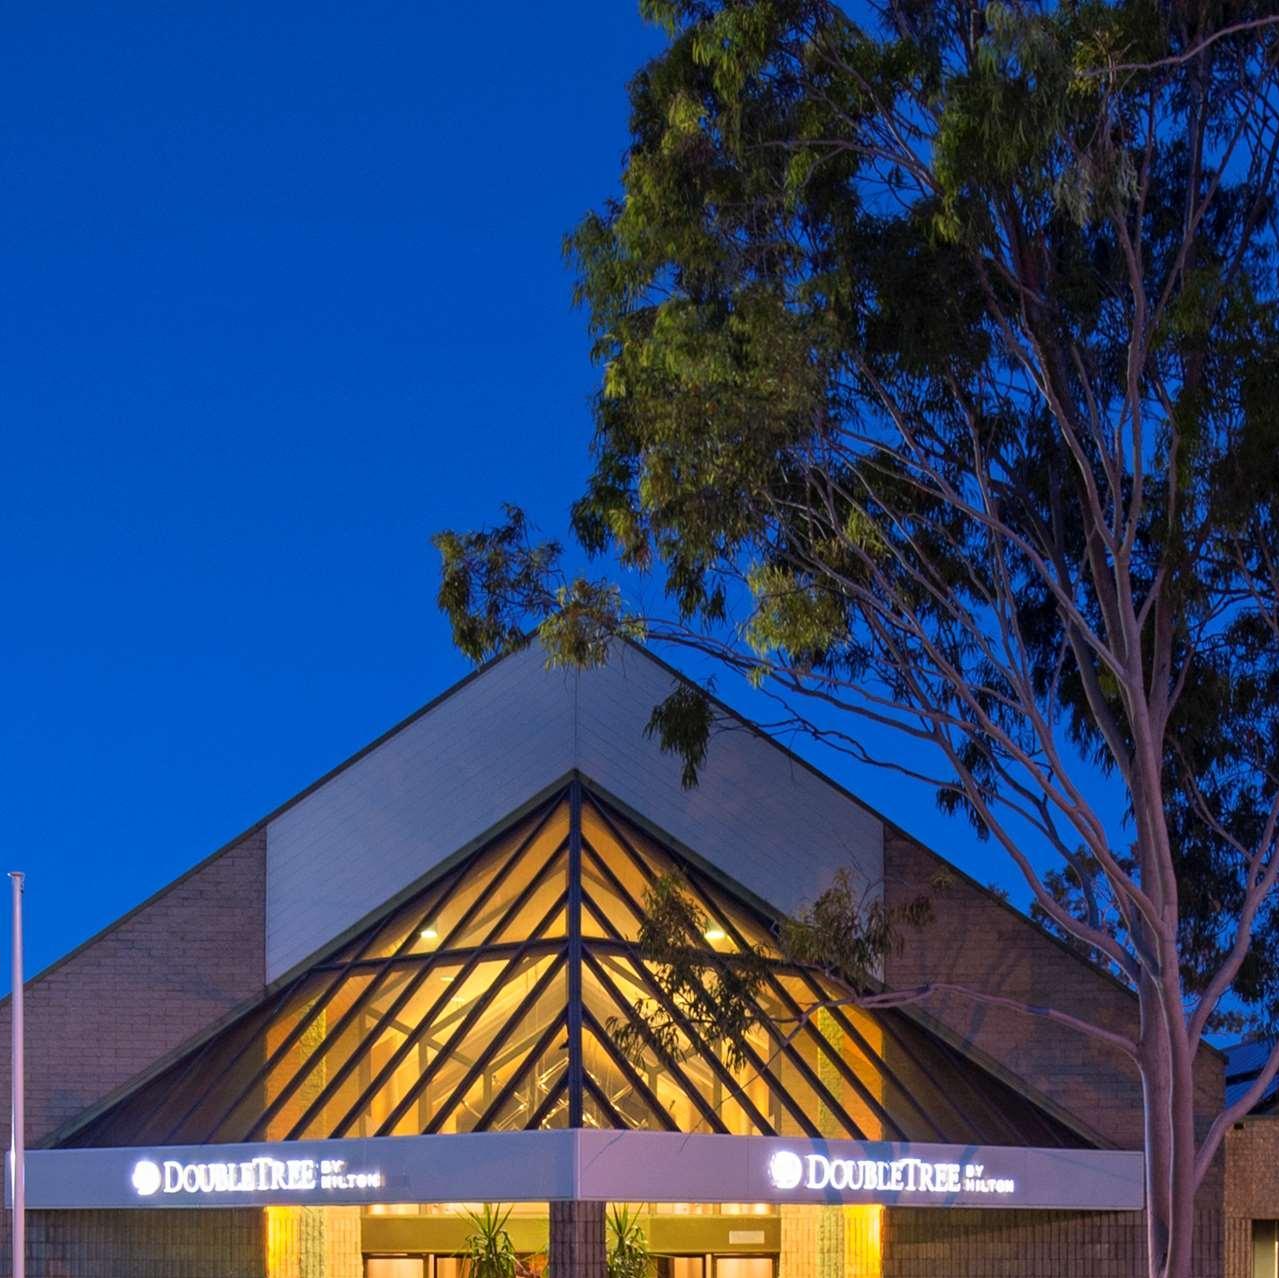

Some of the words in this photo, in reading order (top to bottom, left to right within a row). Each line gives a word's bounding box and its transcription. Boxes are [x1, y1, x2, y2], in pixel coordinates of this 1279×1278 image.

[163, 1157, 316, 1193] DOUBLETREE
[320, 1174, 384, 1189] HILTON
[806, 1154, 960, 1192] DOUBLETREE
